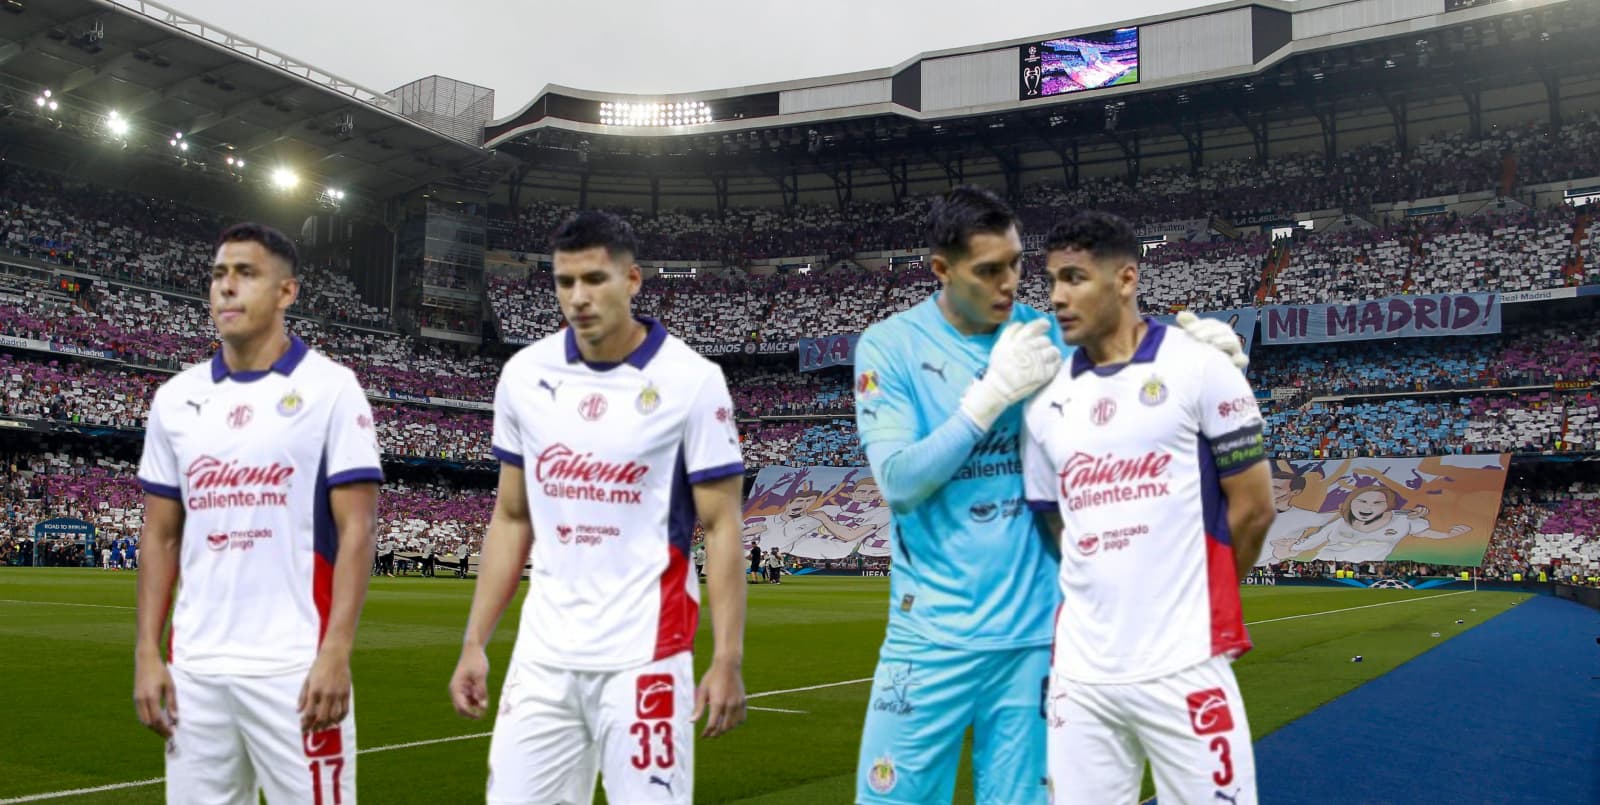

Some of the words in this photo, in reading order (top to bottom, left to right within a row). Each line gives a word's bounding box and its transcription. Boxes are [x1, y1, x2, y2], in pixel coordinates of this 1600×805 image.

[1520, 291, 1552, 301] Madrid
[1268, 308, 1309, 339] MI
[1326, 294, 1496, 337] MADRID!
[185, 455, 294, 490] Caliente
[536, 443, 649, 484] Caliente
[1059, 452, 1172, 498] Caliente
[188, 490, 287, 511] caliente.mx
[544, 481, 642, 504] caliente.mx
[1068, 481, 1171, 512] caliente.mx
[576, 524, 620, 537] mercado
[1102, 524, 1149, 538] mercado
[1103, 537, 1130, 551] pago
[629, 721, 675, 770] 33
[1209, 735, 1234, 787] 3
[308, 757, 345, 805] 17
